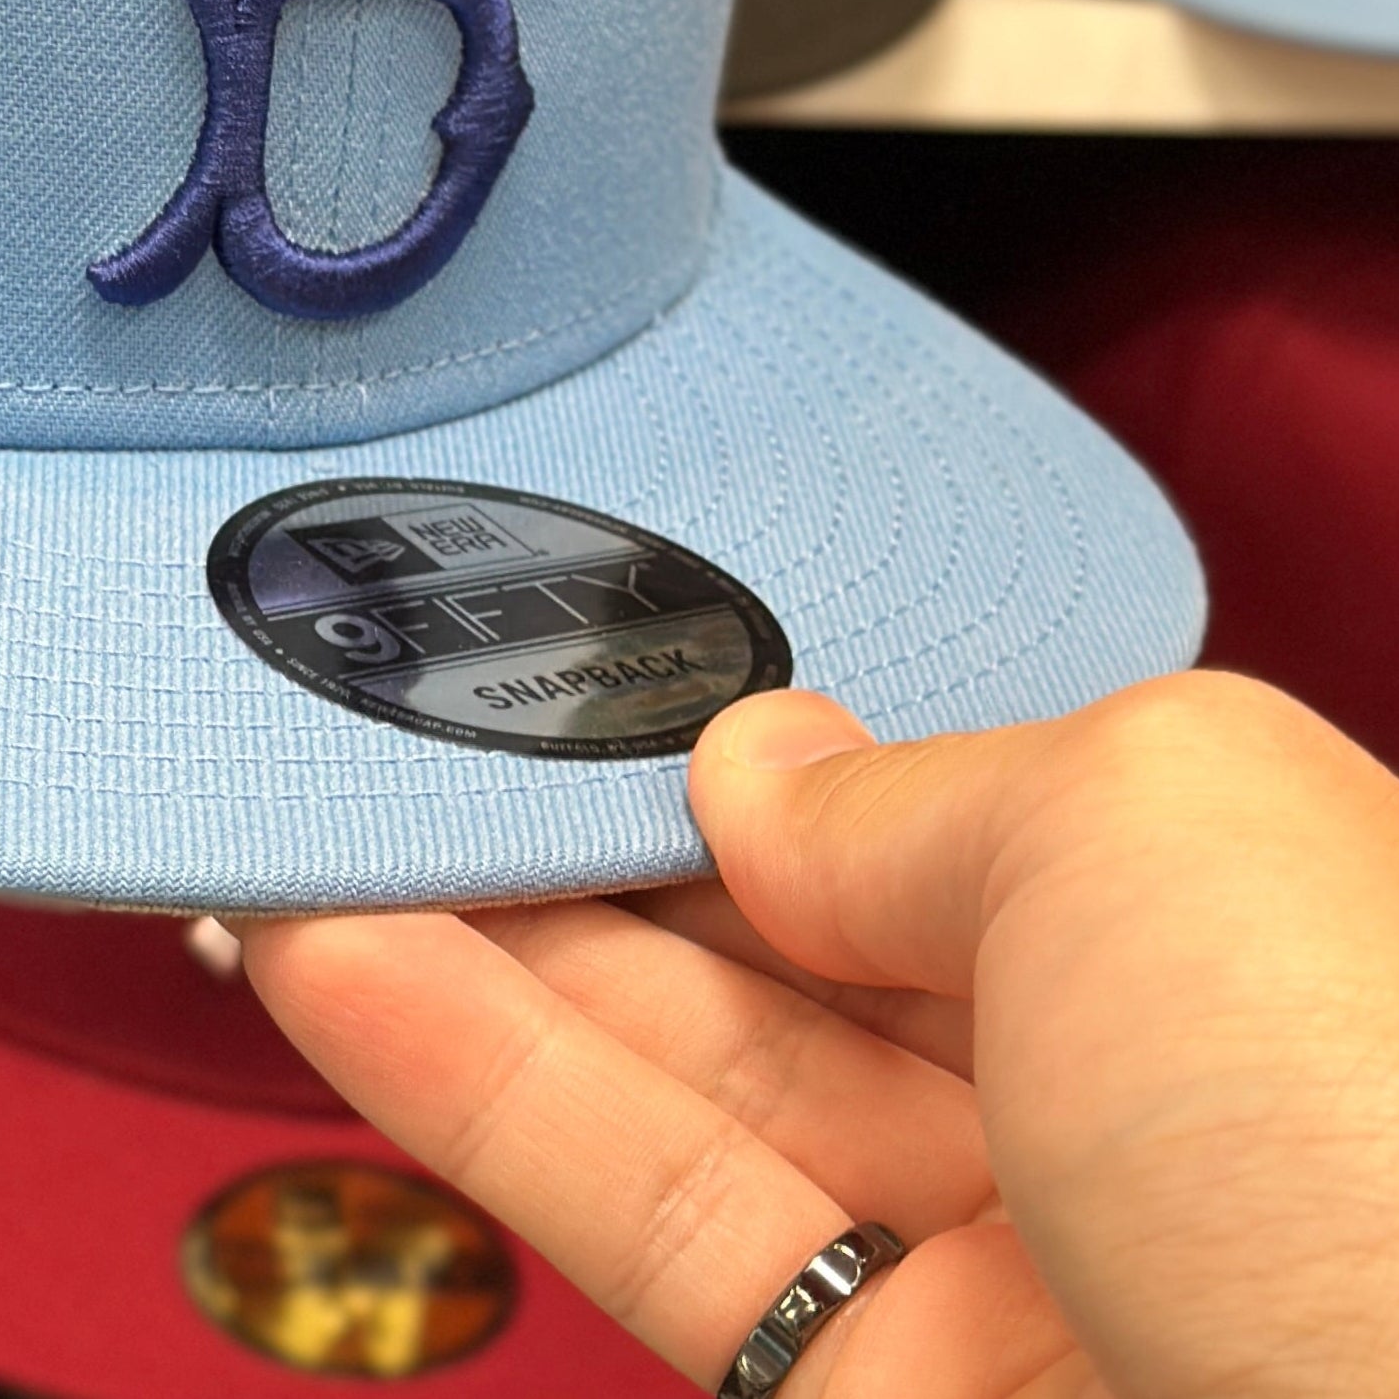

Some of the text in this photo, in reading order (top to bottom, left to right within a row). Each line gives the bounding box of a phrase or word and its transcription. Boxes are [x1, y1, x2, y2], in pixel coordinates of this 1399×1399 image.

[409, 516, 485, 541] NEW
[431, 532, 508, 557] ERA
[313, 563, 660, 665] 9FIFTY
[472, 648, 705, 712] SNAPBACK
